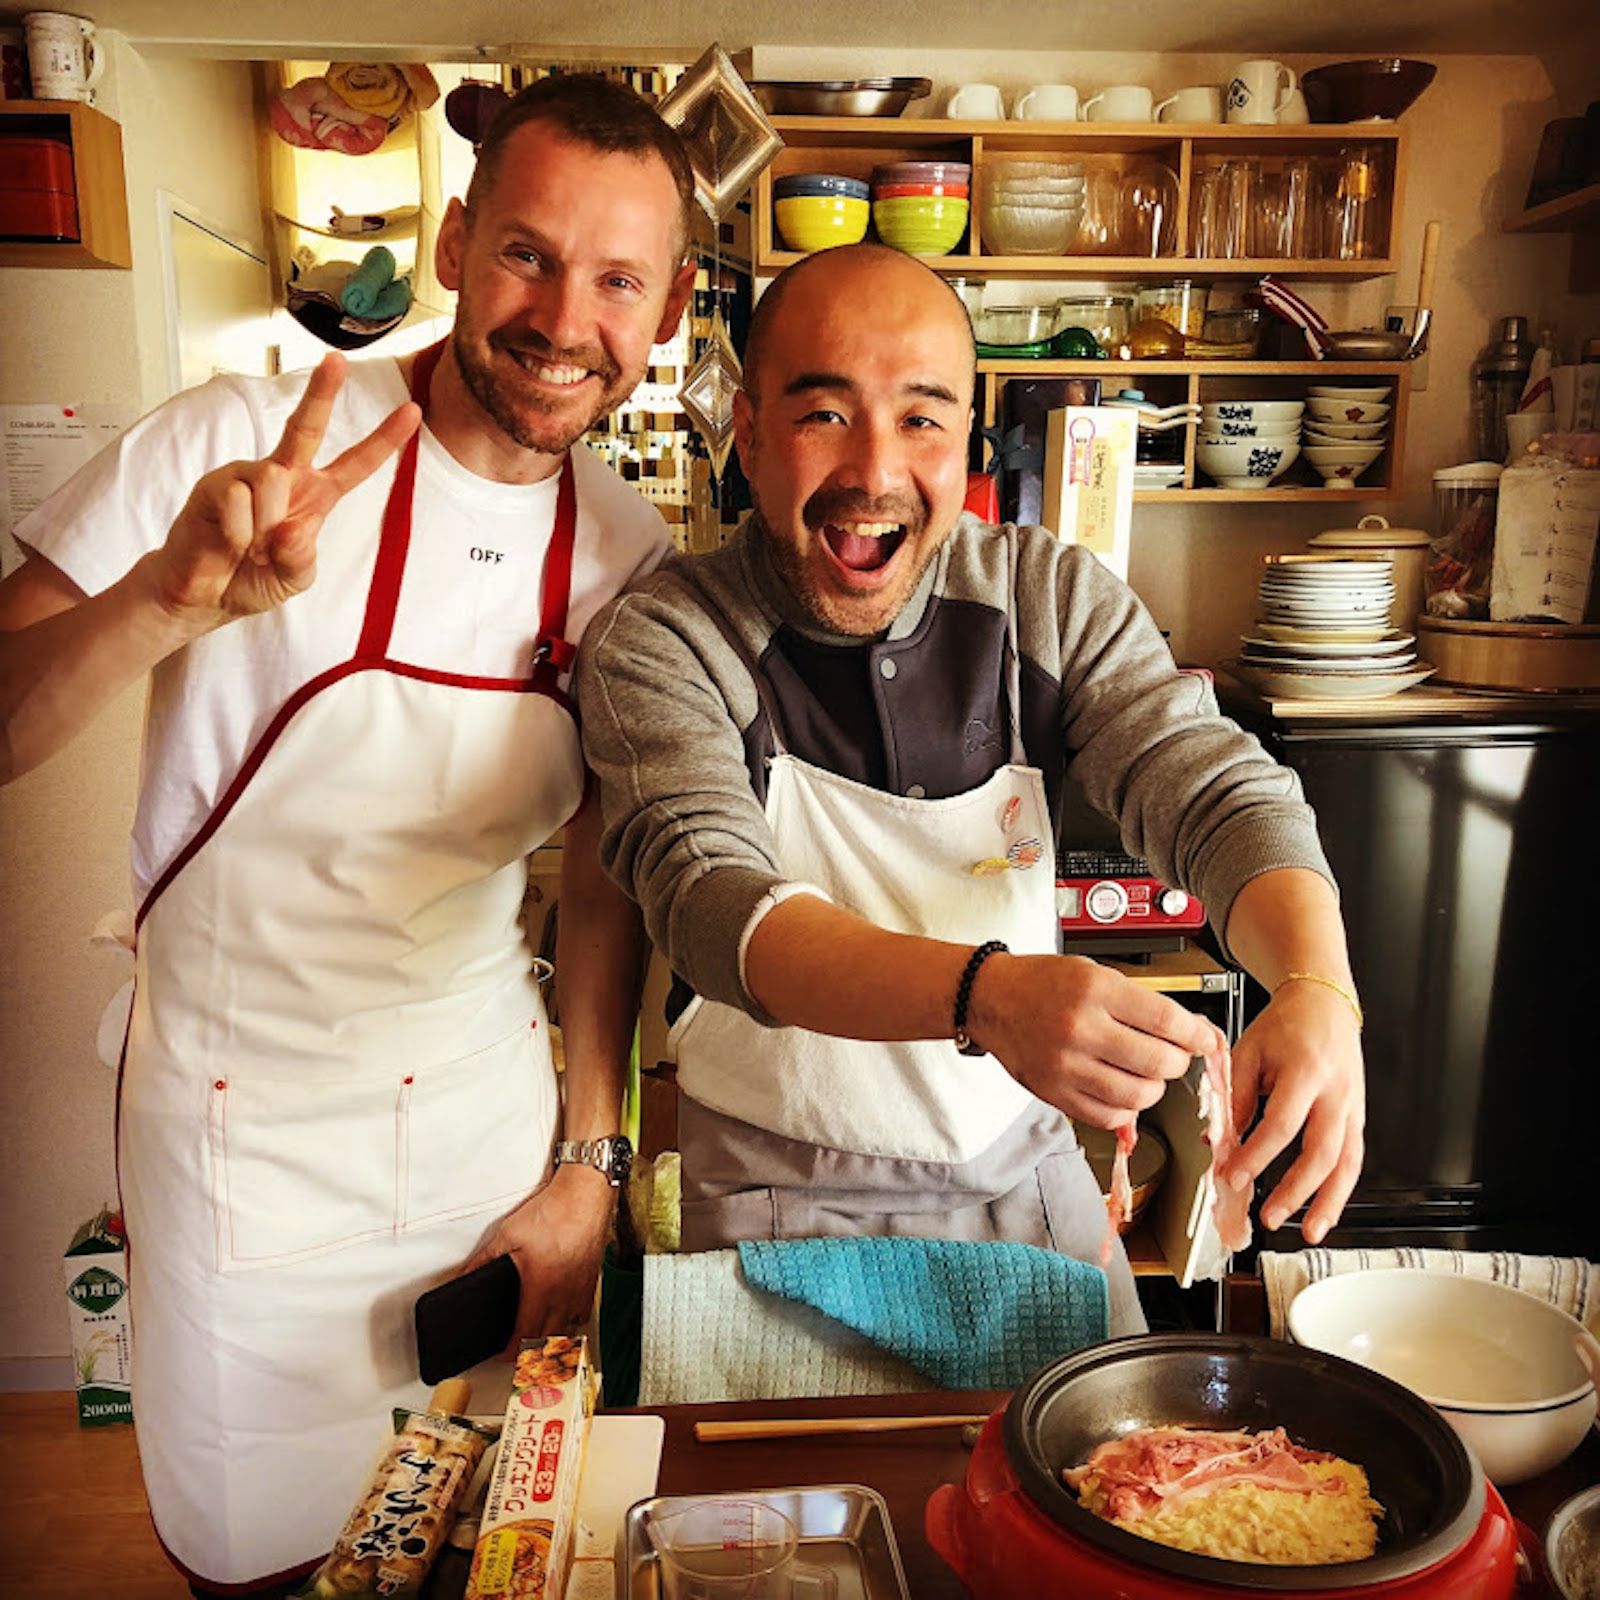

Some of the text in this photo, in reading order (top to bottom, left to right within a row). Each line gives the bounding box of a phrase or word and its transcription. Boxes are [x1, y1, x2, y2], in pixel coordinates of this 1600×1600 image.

[504, 1413, 542, 1513] クッキングシート
